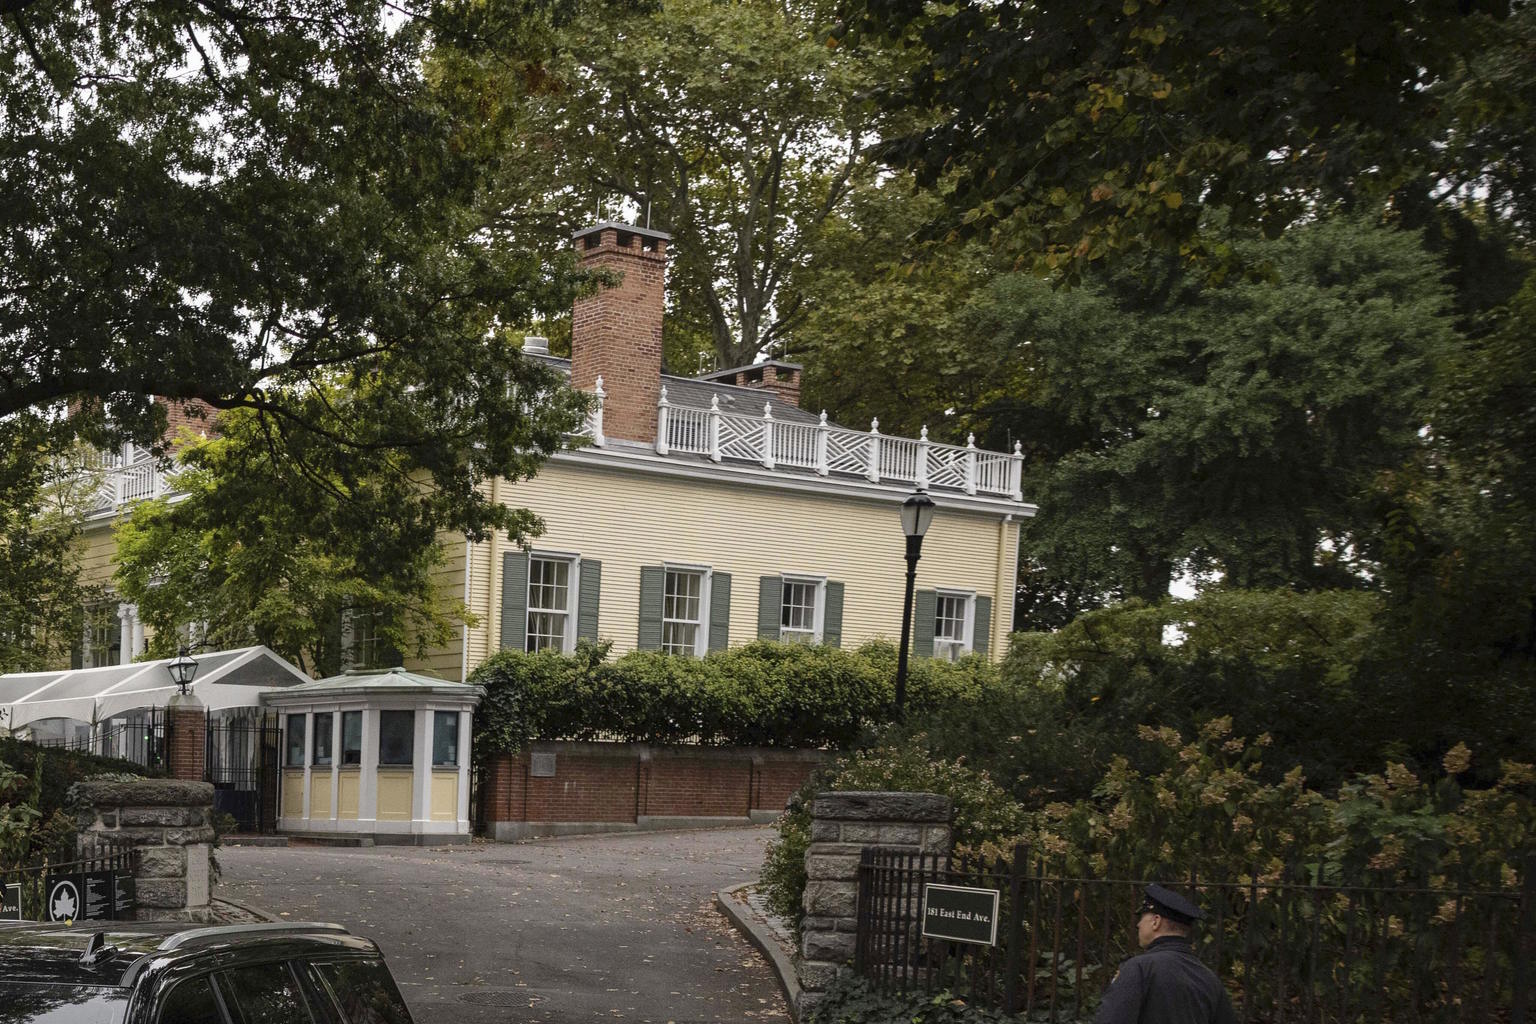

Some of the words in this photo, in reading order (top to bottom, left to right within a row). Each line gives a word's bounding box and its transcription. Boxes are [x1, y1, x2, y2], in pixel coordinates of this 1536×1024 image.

[927, 907, 938, 916] 181
[940, 908, 955, 918] East
[956, 910, 972, 920] End
[973, 913, 990, 923] Ave.
